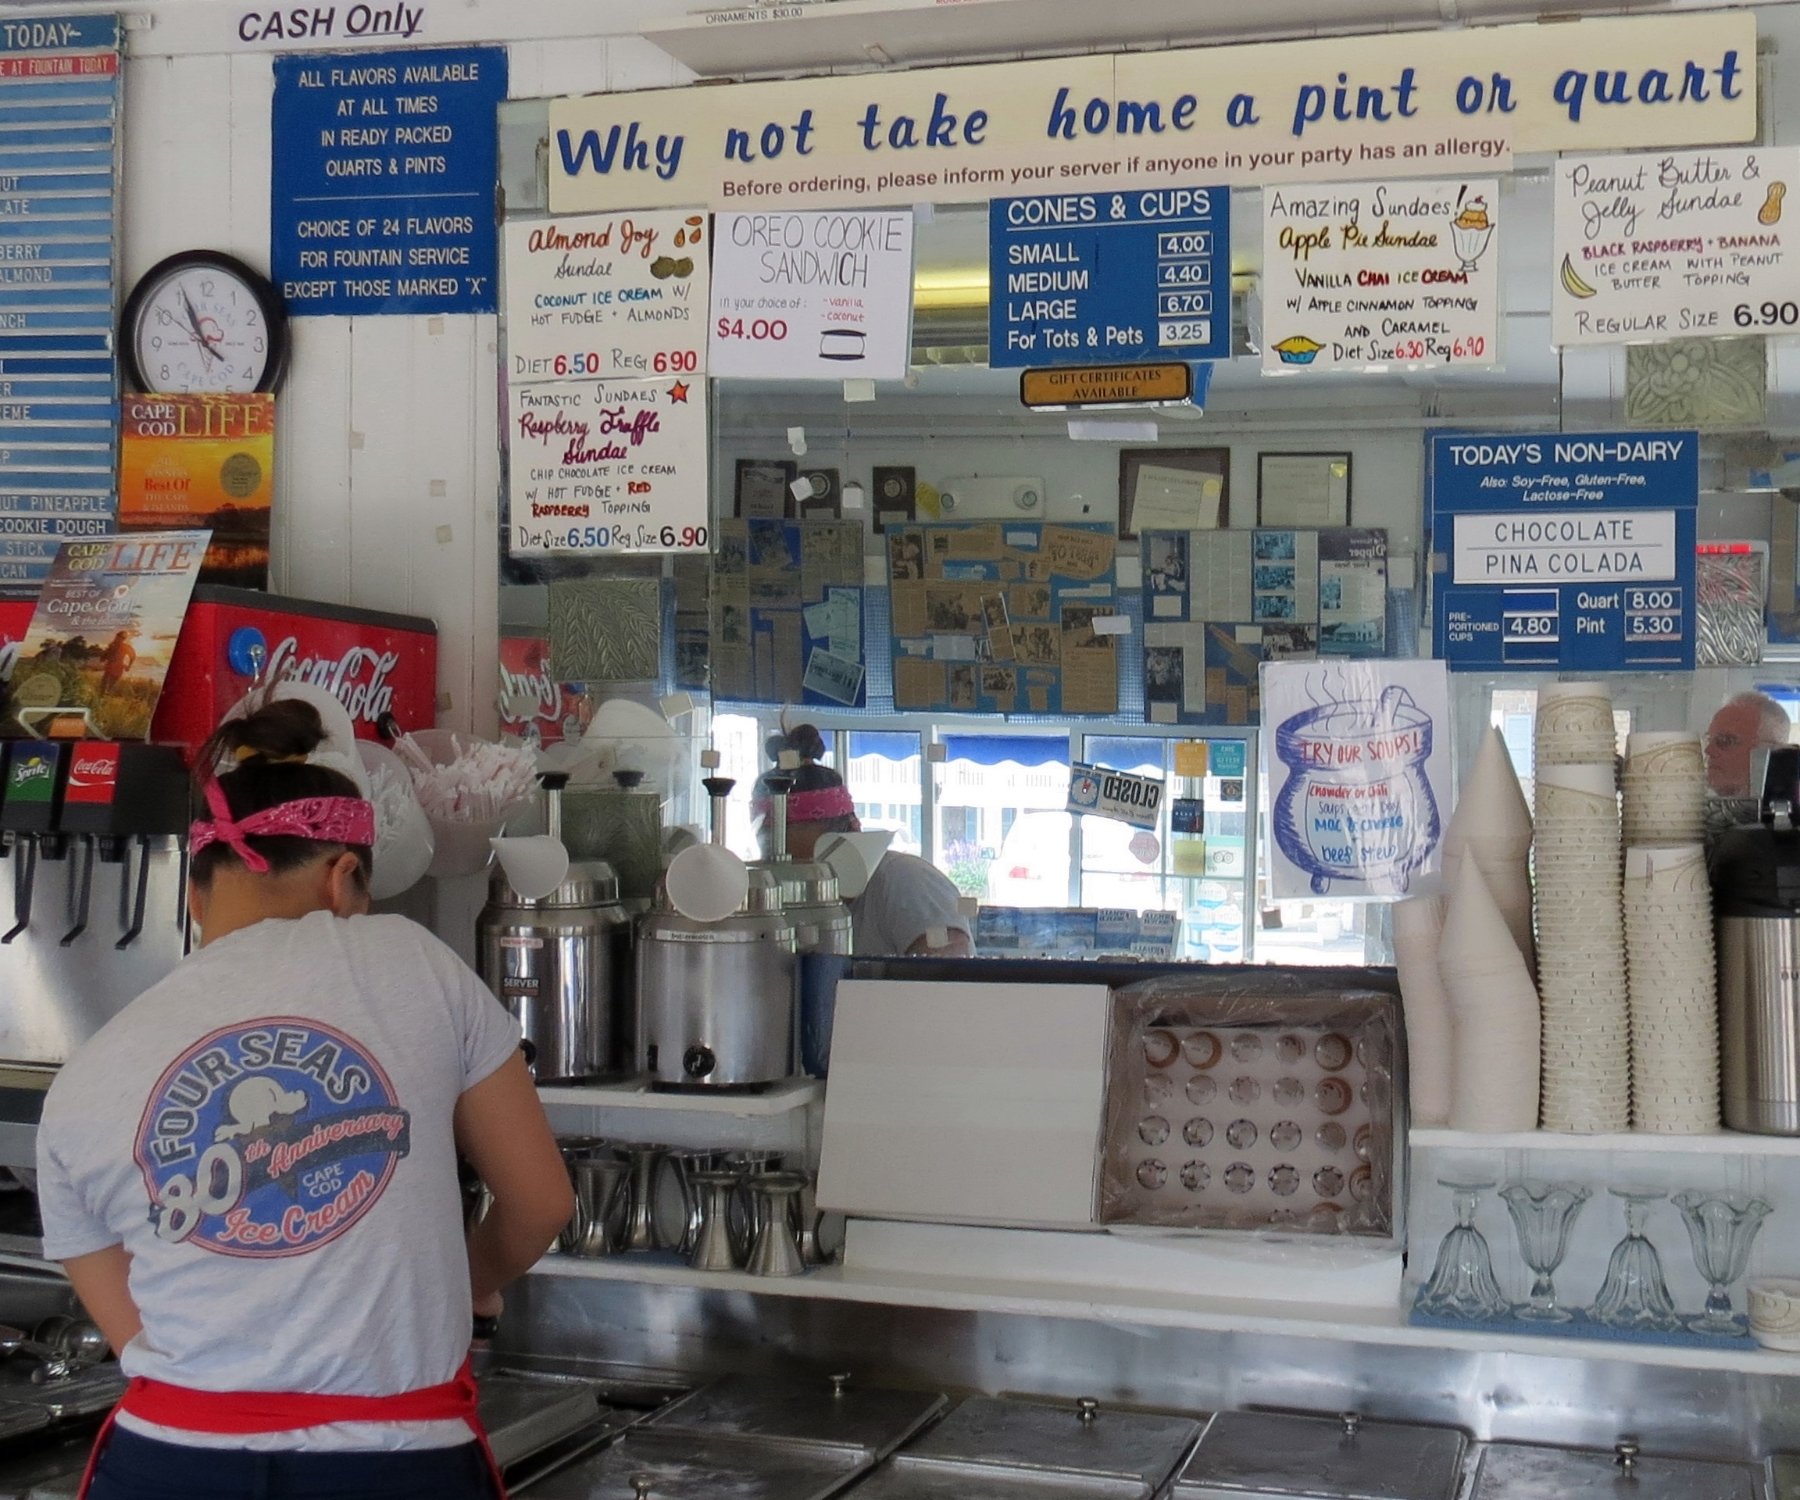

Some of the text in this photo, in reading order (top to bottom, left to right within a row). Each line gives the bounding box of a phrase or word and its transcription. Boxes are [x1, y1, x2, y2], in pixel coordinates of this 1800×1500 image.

[238, 2, 423, 42] CASH Only
[706, 7, 803, 24] ORNAMENTS $30.00
[12, 57, 108, 75] AT FOUNTAIN TODAY
[299, 64, 479, 88] ALL FLAVORS AVAILABLE
[337, 96, 438, 116] AT ALL TIMES
[556, 50, 1743, 180] Why not take home a pint or quart
[321, 125, 452, 146] IN READY PACKED
[326, 157, 446, 177] QUARTS & PINTS
[722, 137, 1511, 197] Before ordering, please inform your server if anyone in your party has an allergy.
[1566, 155, 1760, 197] Peanut Butter &
[1008, 189, 1211, 225] CONES & CUPS
[1271, 191, 1359, 224] Amazing
[1581, 188, 1743, 240] Jelly Sundae
[298, 217, 473, 238] CHOICE OF 24 FLAVORS
[529, 219, 658, 259] Almond Joy
[732, 215, 904, 251] OREO COOKIE
[301, 248, 469, 268] FOR FOUNTAIN SERVICE
[1009, 235, 1205, 264] SMALL 4.00
[554, 253, 613, 279] Sundae
[760, 250, 868, 288] SANDWICH
[1595, 252, 1783, 277] ICE CREAM WITH PEANUT
[284, 281, 337, 298] EXCEPT
[344, 280, 390, 297] THOSE
[398, 278, 458, 296] MARKED
[1009, 265, 1202, 293] MEDIUM 4.40
[1009, 295, 1204, 322] LARGE 6.70
[1734, 301, 1799, 326] 6.90
[717, 317, 787, 341] $4.00
[1008, 324, 1203, 349] For Tots & Pets 3.25
[516, 355, 552, 374] DIET
[554, 352, 600, 375] 6.50
[653, 351, 697, 372] 690
[1050, 369, 1161, 385] GIFT CERTIFICATES
[1073, 386, 1138, 399] AVAILABLE
[132, 404, 263, 437] CAPE LIFE
[138, 422, 176, 436] COD
[1450, 440, 1683, 466] TODAY'S NON-DAIRY
[144, 478, 190, 491] Best Of
[1511, 475, 1571, 488] Soy-Free,
[1575, 473, 1646, 487] Gluten-Free,
[31, 496, 107, 511] PINEAPPLE
[1523, 489, 1604, 502] Lactose-Free
[56, 519, 106, 534] DOUGH
[1495, 520, 1633, 542] CHOCOLATE
[67, 542, 197, 571] CAPE LIFE
[68, 558, 105, 571] COD
[1486, 552, 1643, 574] PINA COLADA
[1577, 591, 1673, 611] Quart 8.00
[1449, 612, 1472, 622] PRE-
[1449, 622, 1499, 632] PORTIONED
[1511, 617, 1551, 635] 4.80
[1577, 616, 1673, 634] Pint 5.30
[1449, 633, 1474, 642] CUPS
[1301, 731, 1420, 766] TRY OUR SOUPS!
[16, 763, 49, 782] Sprite
[504, 978, 539, 989] SERVER
[151, 1028, 371, 1168] FOUR SEAS
[157, 1142, 242, 1244] 80
[268, 1112, 404, 1178] Anniversary
[302, 1163, 344, 1187] CAPE
[309, 1178, 342, 1198] COD
[216, 1169, 375, 1244] Ice Cream
